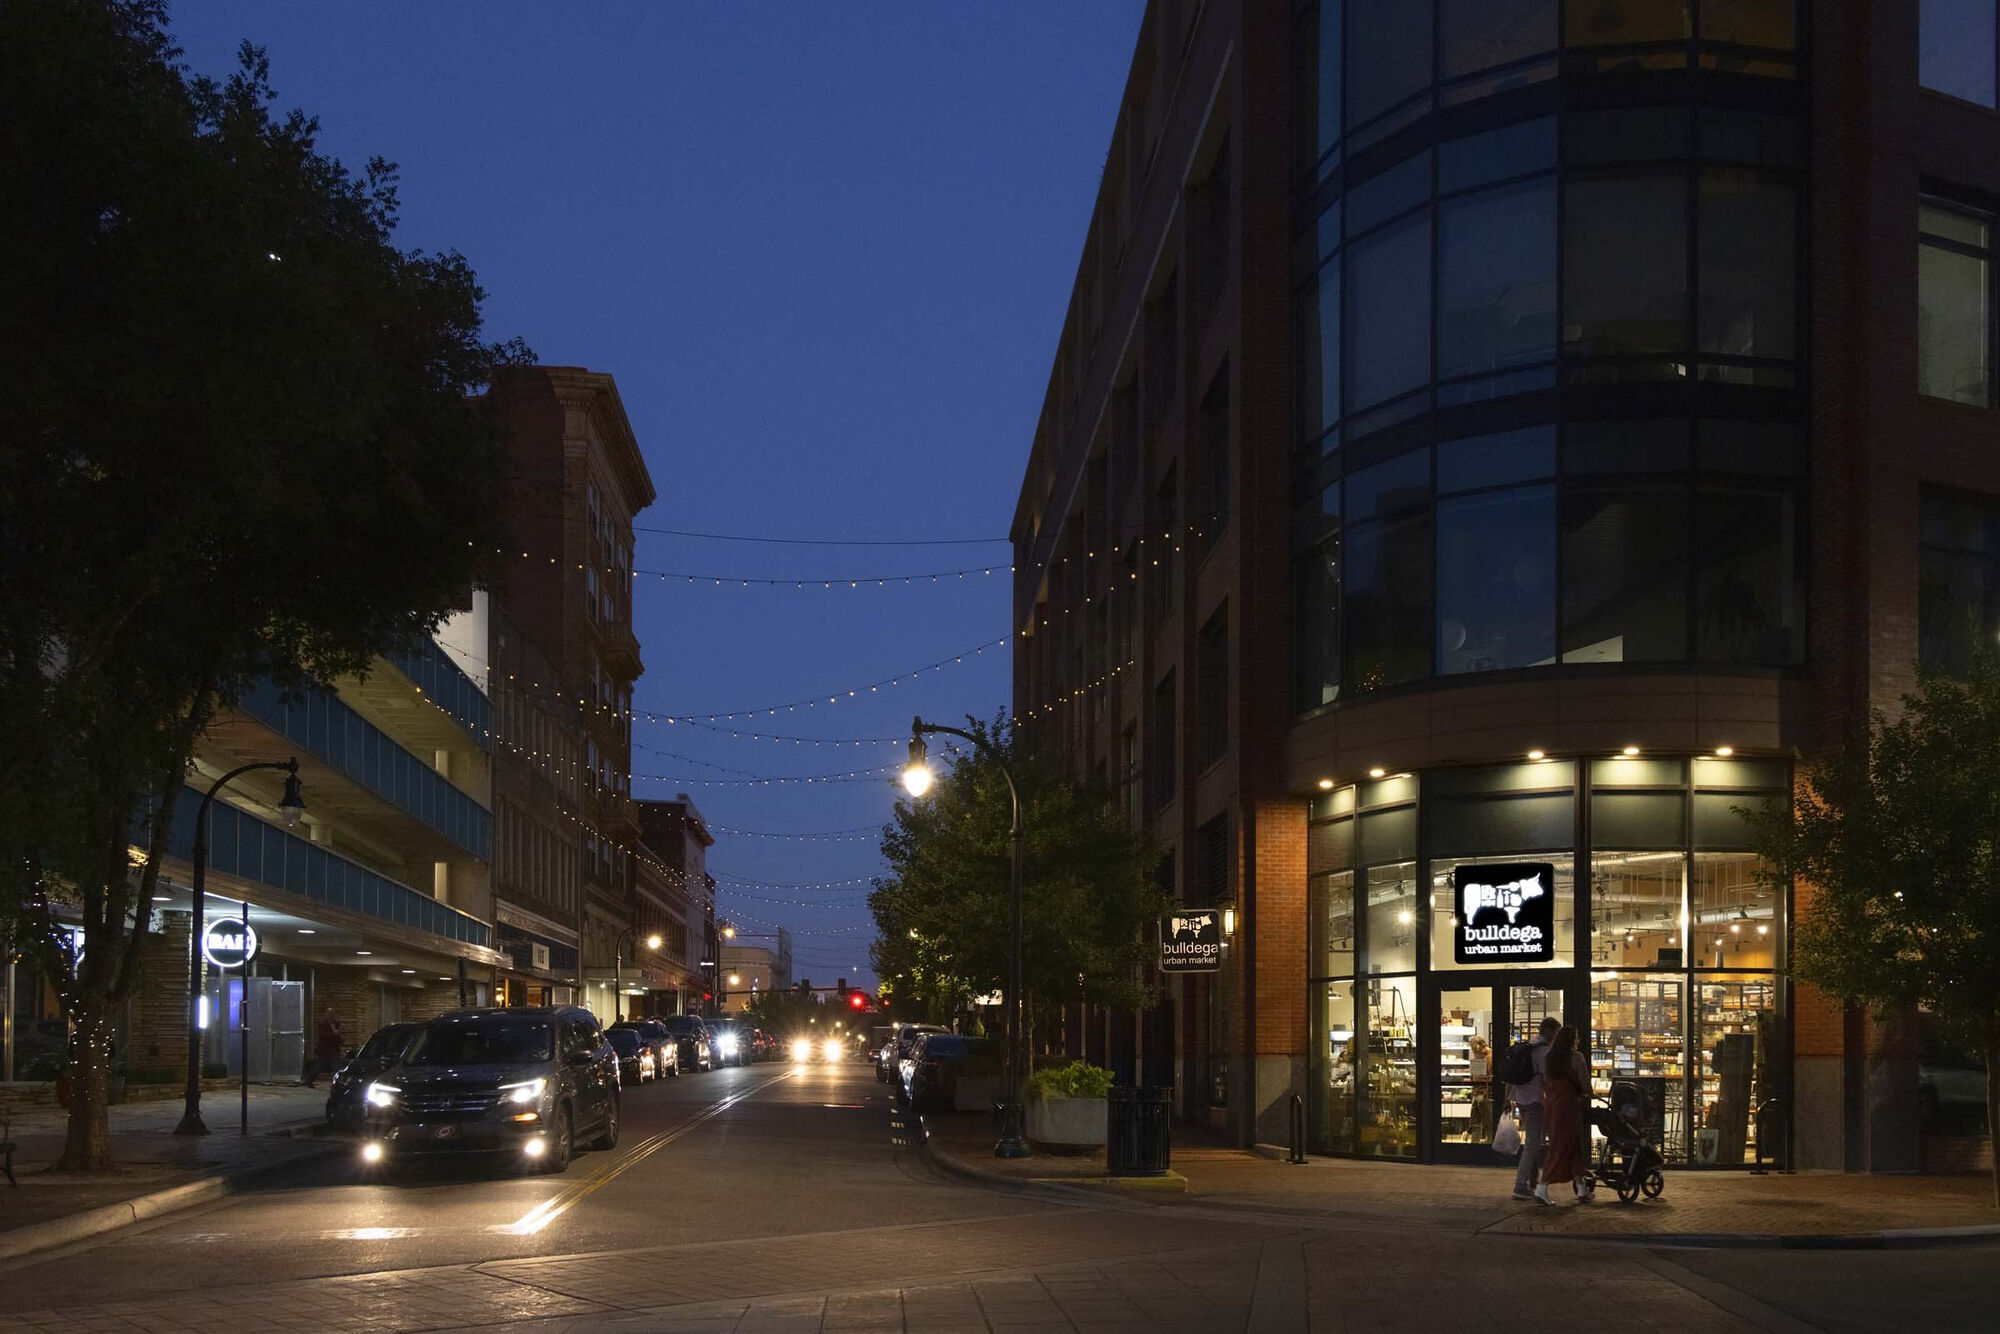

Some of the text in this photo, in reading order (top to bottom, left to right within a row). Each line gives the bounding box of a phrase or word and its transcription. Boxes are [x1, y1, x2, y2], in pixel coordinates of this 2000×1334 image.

[1464, 925, 1542, 942] bulldega
[1164, 942, 1218, 956] bulldega
[1464, 943, 1542, 954] urban market
